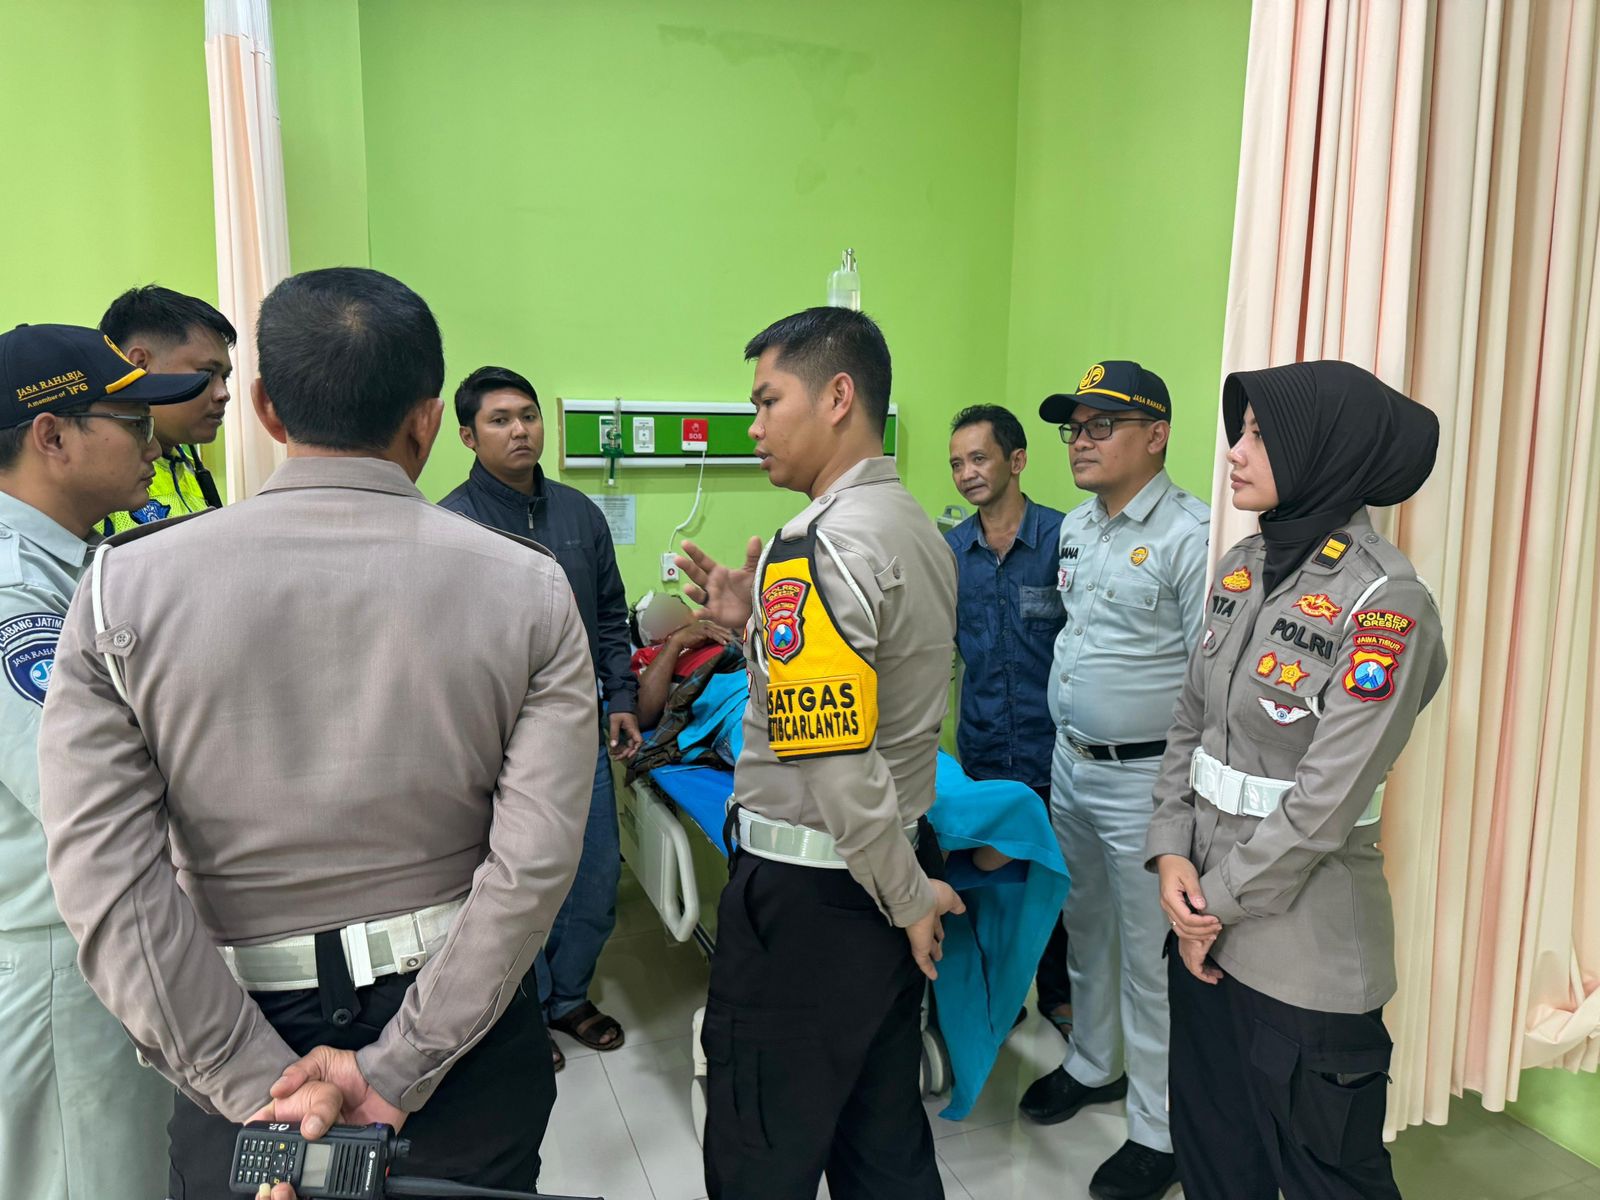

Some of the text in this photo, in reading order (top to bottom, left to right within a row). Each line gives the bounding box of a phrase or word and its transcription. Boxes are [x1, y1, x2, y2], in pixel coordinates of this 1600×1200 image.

[16, 370, 84, 398] JASA RAHARJA
[1132, 394, 1146, 405] JASA
[1357, 612, 1409, 628] POLRES
[1362, 620, 1402, 631] GRESIK
[0, 617, 62, 641] CABANG JATIM
[1271, 618, 1334, 660] POLRI
[1356, 636, 1401, 651] JAWA TIMUR
[13, 655, 31, 667] JASA
[767, 683, 855, 715] SATGAS
